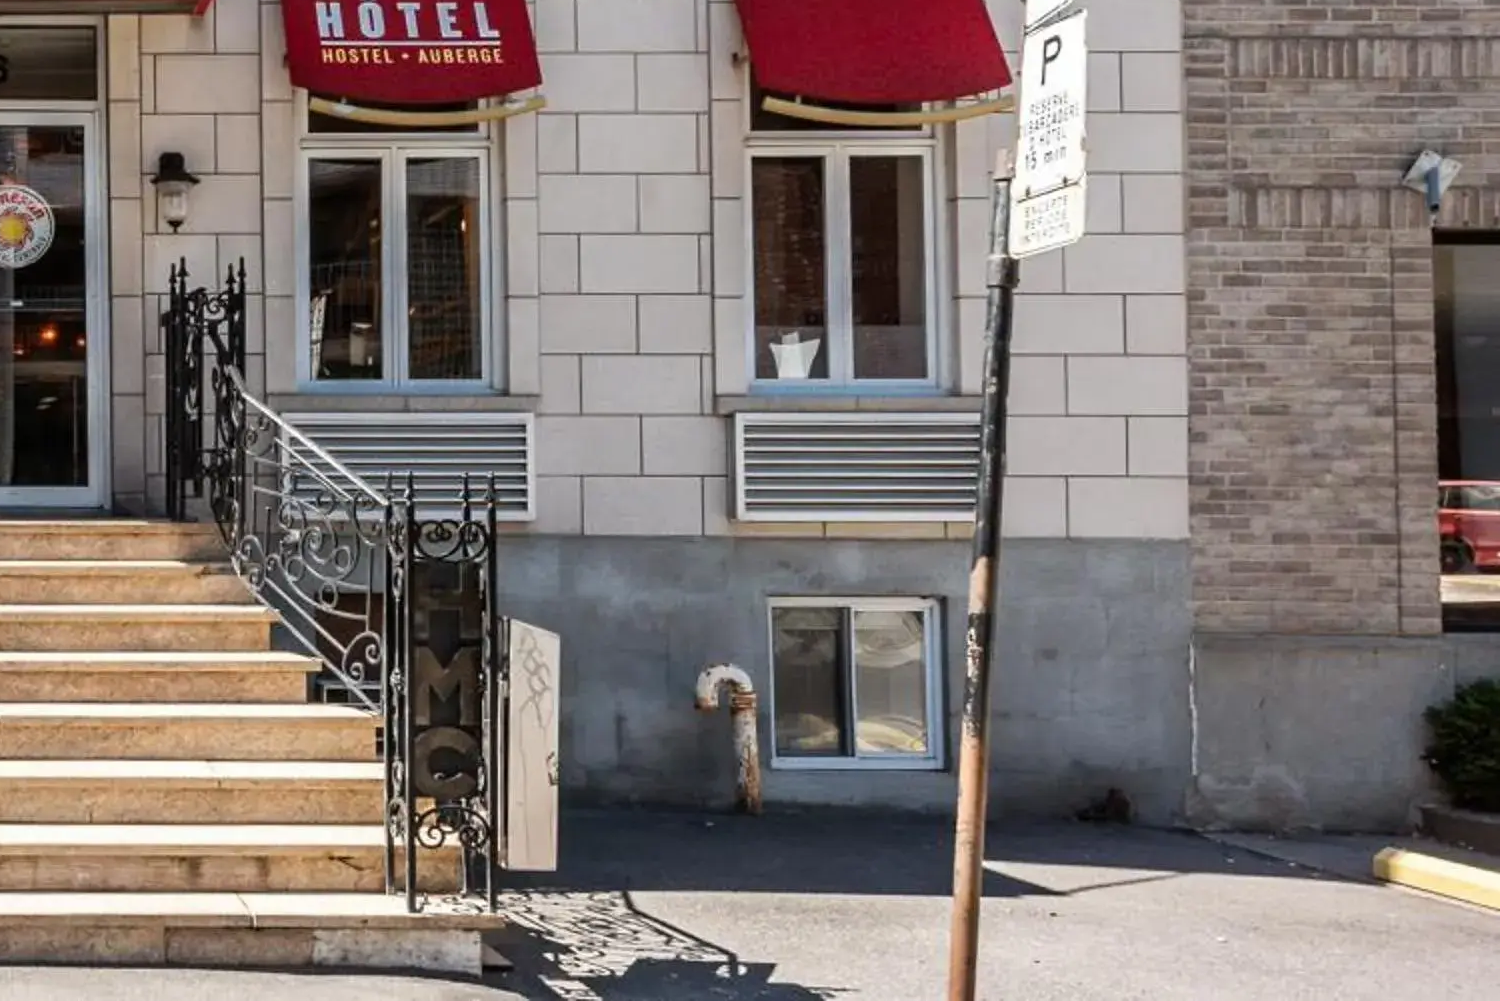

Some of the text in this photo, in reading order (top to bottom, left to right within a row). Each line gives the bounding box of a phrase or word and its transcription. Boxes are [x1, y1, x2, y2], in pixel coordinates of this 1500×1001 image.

[321, 47, 504, 63] HOSTEL AUBERGE
[1041, 35, 1063, 86] P
[414, 563, 480, 798] HMC
